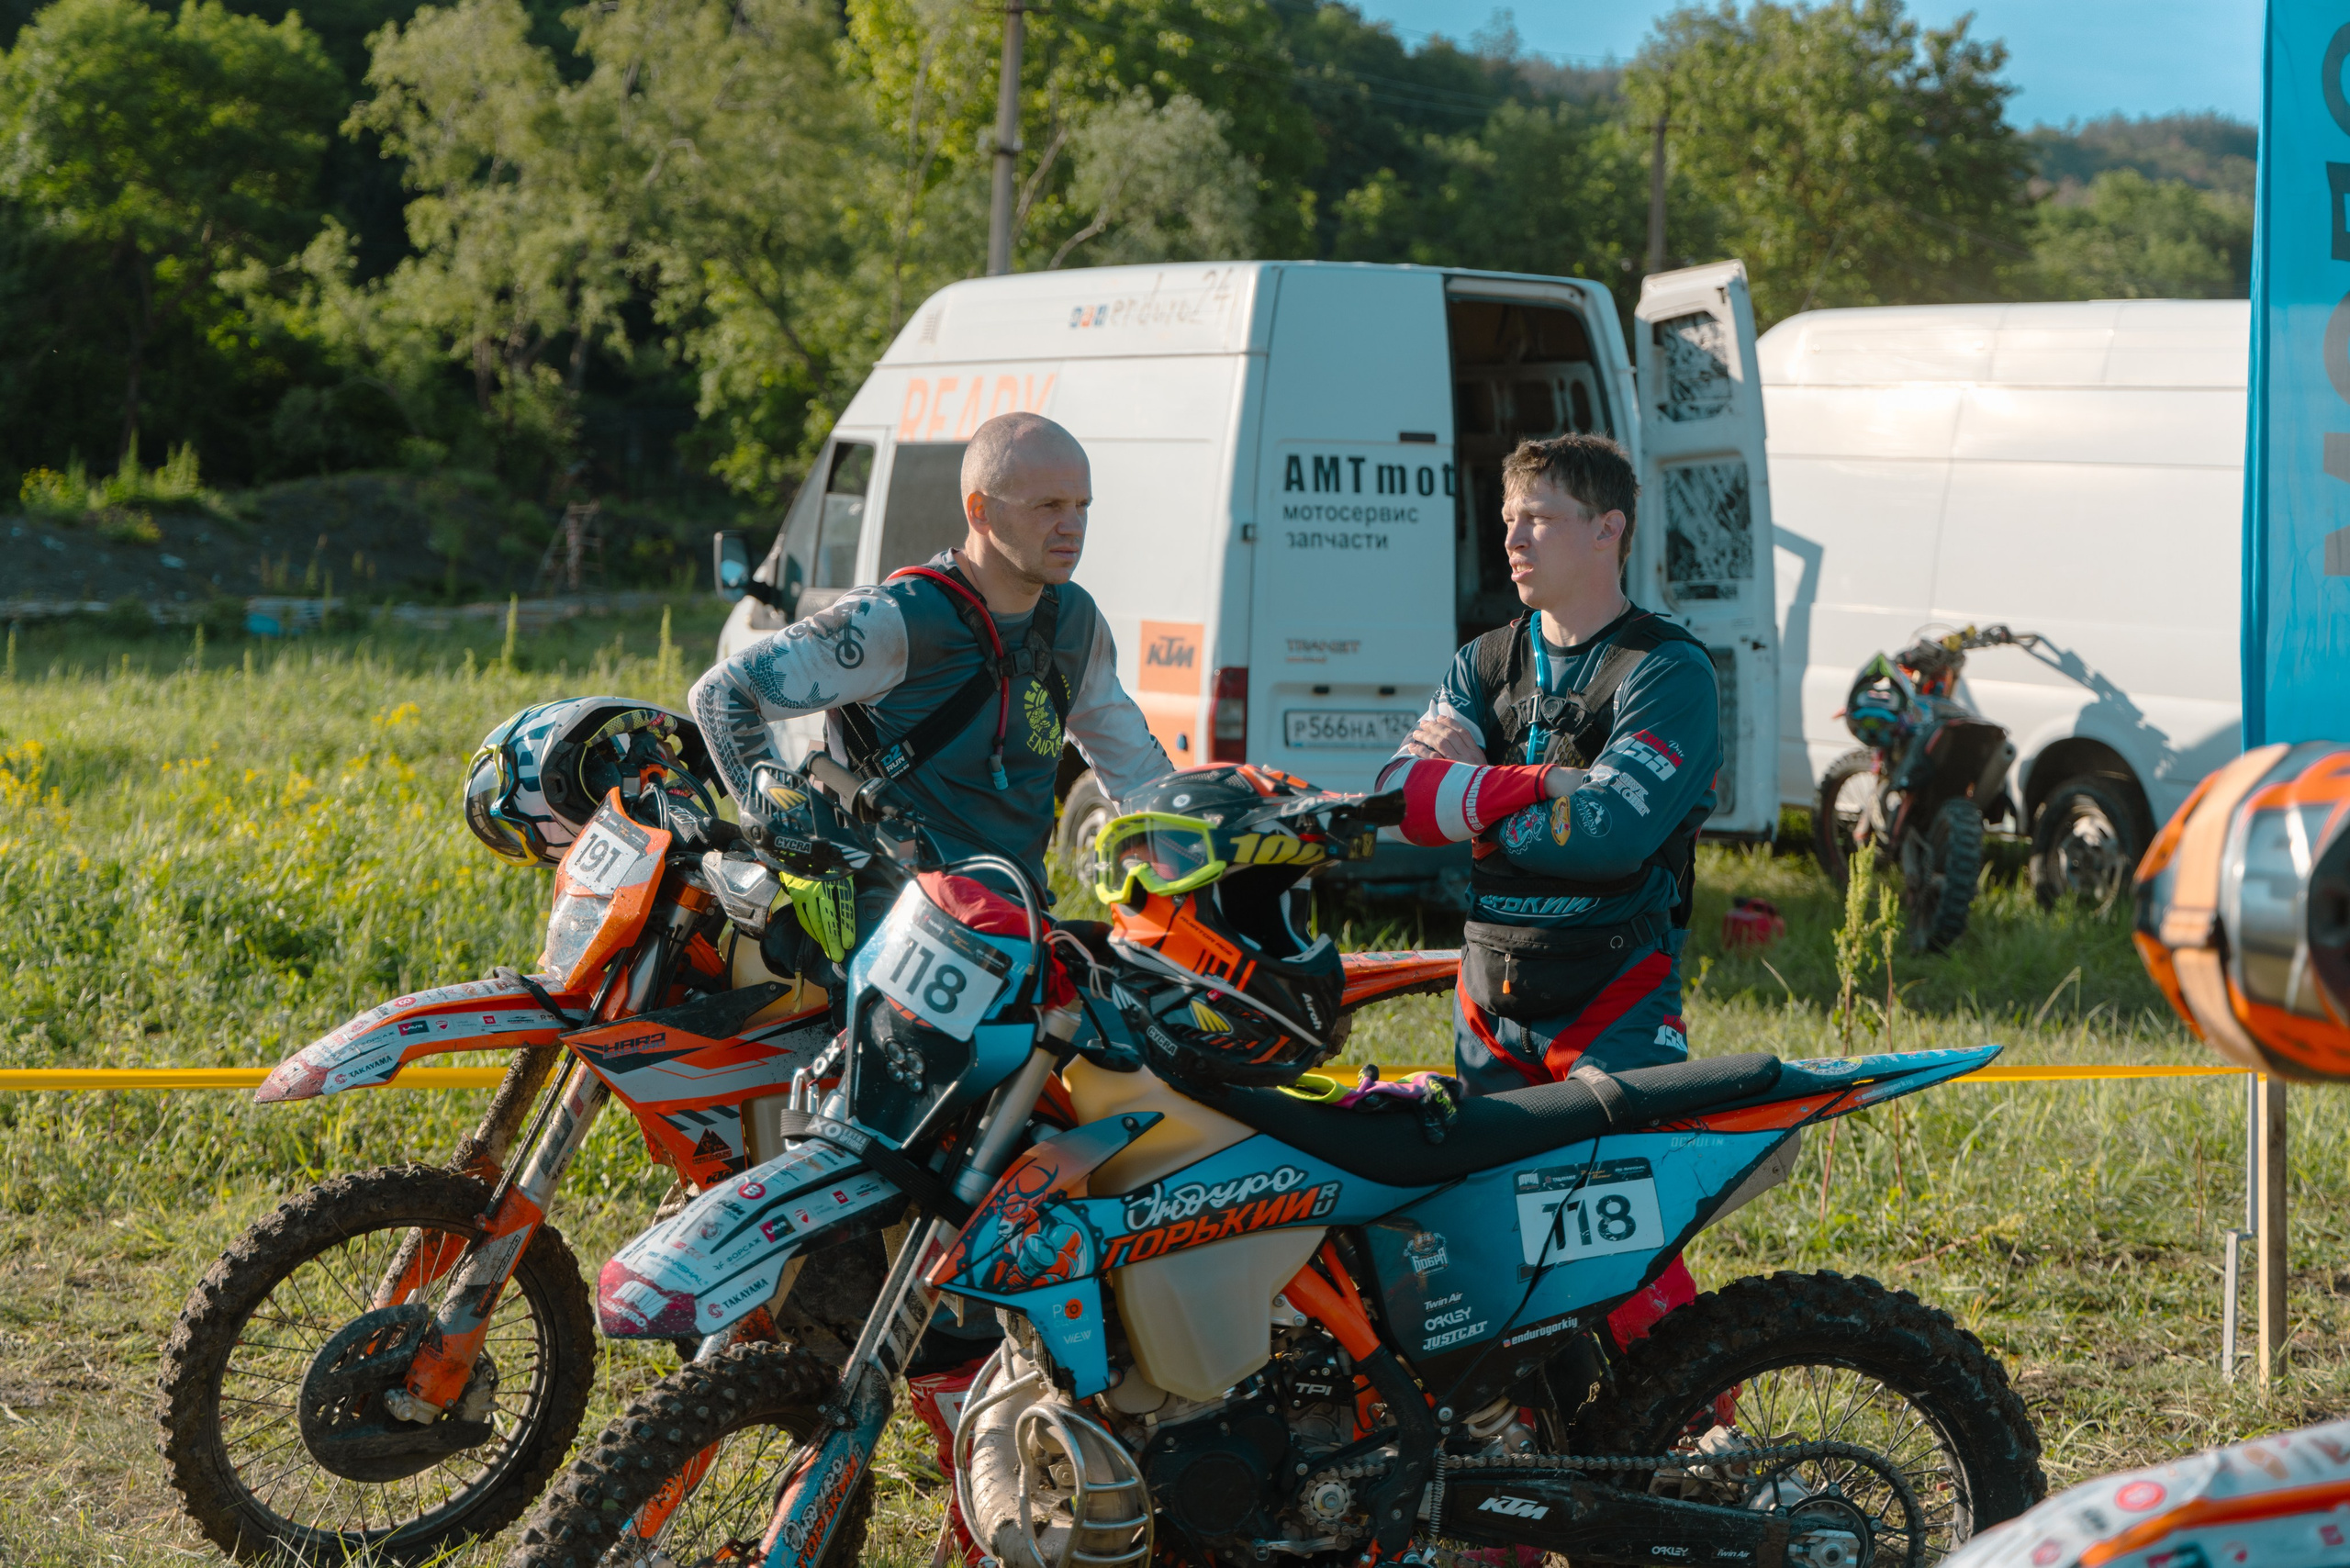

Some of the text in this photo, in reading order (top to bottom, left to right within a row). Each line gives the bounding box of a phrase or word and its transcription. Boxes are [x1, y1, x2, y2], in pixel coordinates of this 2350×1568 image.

[1283, 506, 1419, 526] мотосервис
[1287, 532, 1388, 549] запчасти
[1146, 635, 1195, 668] KTM
[886, 756, 905, 772] RUN
[775, 836, 811, 855] CYCRA
[575, 833, 621, 882] 191
[890, 938, 967, 1014] 118
[1302, 992, 1322, 1030] Airoh
[602, 1039, 666, 1060] ENDURO
[603, 1032, 666, 1052] HARD
[1146, 1025, 1179, 1056] CYCRA
[349, 1055, 393, 1079] TAKAYAMA
[1862, 1078, 1914, 1101] endurogorkiy
[839, 1136, 864, 1151] OPTIONS
[842, 1128, 867, 1145] EXTRA
[1126, 1167, 1304, 1230] Эндуро
[1412, 1247, 1449, 1273] БОБРА
[722, 1278, 769, 1309] TAKAYAMA
[1424, 1292, 1463, 1311] Twin Air
[1425, 1306, 1472, 1331] OAKLEY
[1063, 1329, 1091, 1344] VIEW
[1423, 1320, 1488, 1350] JUSTCAT
[1511, 1316, 1578, 1346] endurogorkiy
[1295, 1383, 1331, 1396] TPI
[1477, 1496, 1550, 1520] KTM
[1651, 1546, 1689, 1557] OAKLEY
[1717, 1548, 1751, 1558] Twin Air
